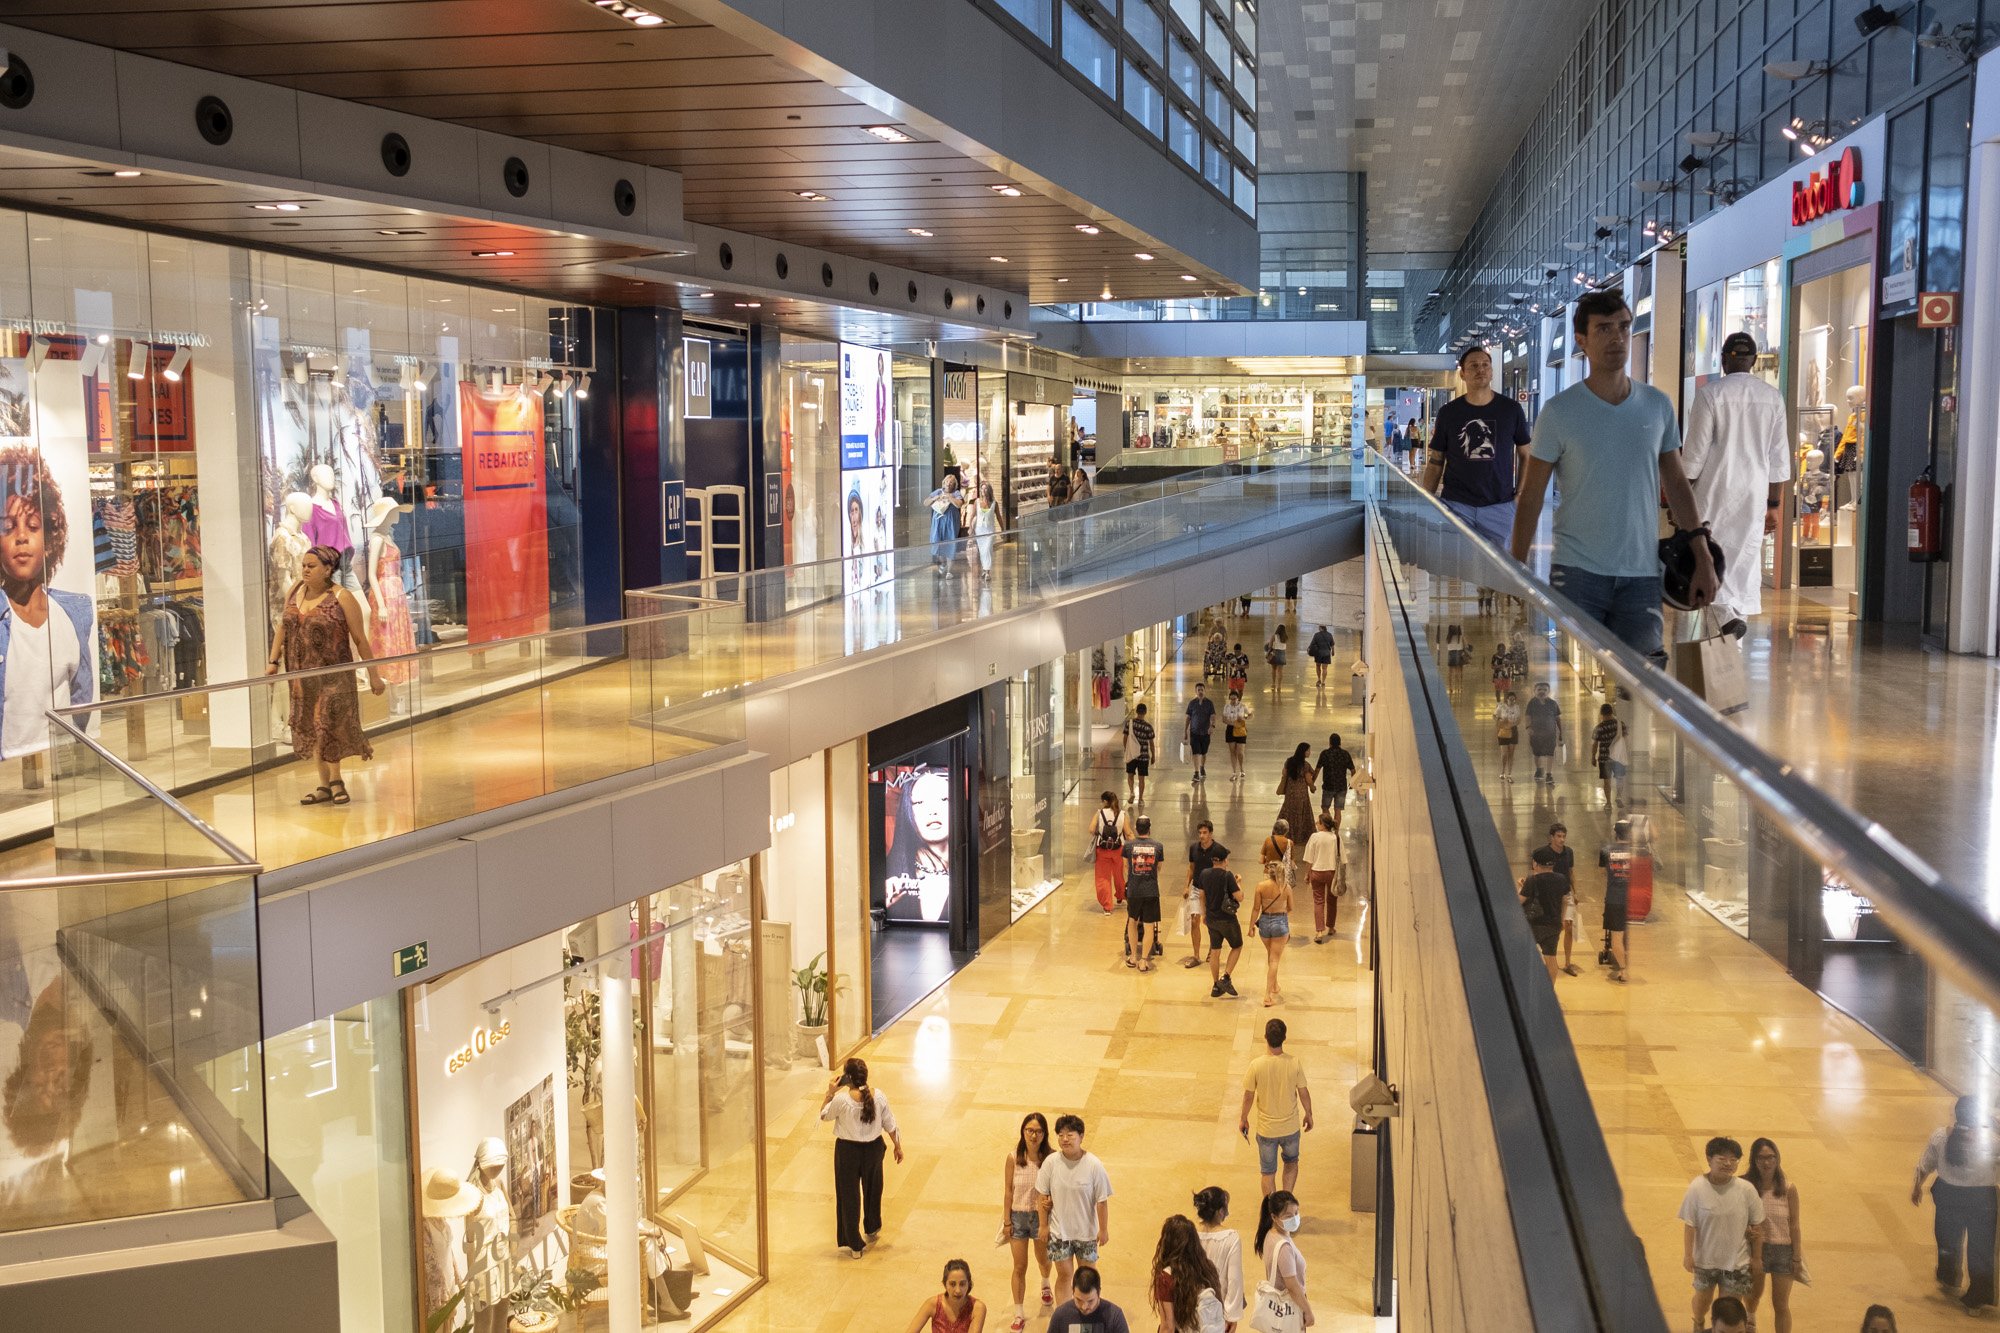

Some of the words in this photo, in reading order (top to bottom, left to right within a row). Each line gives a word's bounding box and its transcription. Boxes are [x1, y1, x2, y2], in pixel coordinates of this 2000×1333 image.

[690, 361, 707, 397] GAP
[479, 451, 529, 469] REBAIXES
[668, 494, 681, 520] GAP
[449, 1047, 472, 1073] ese
[489, 1021, 511, 1046] ese
